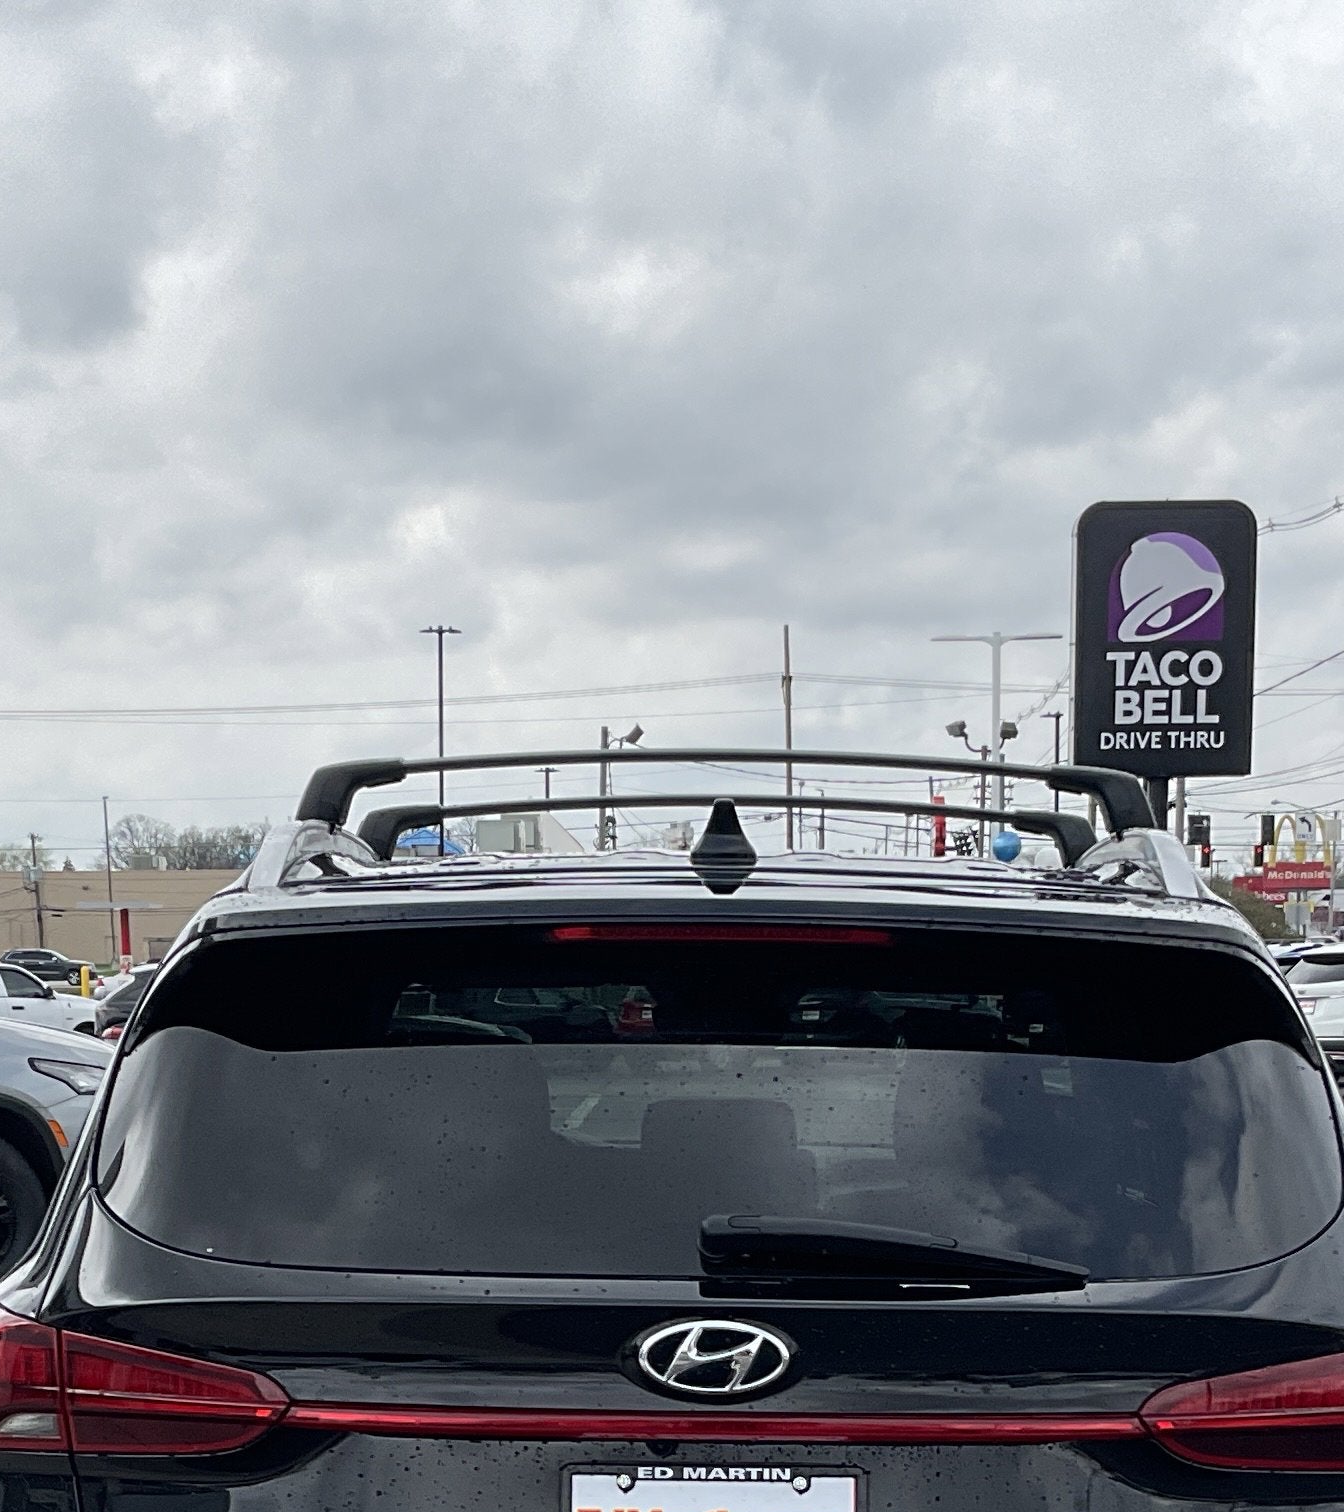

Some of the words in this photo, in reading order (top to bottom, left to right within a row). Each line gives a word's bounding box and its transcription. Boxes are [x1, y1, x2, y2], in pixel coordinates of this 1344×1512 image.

[1106, 650, 1223, 686] TACO
[1114, 689, 1220, 725] BELL
[1100, 732, 1162, 749] DRIVE
[1167, 731, 1225, 749] THRU
[637, 1466, 674, 1480] ED
[682, 1466, 791, 1481] MARTIN
